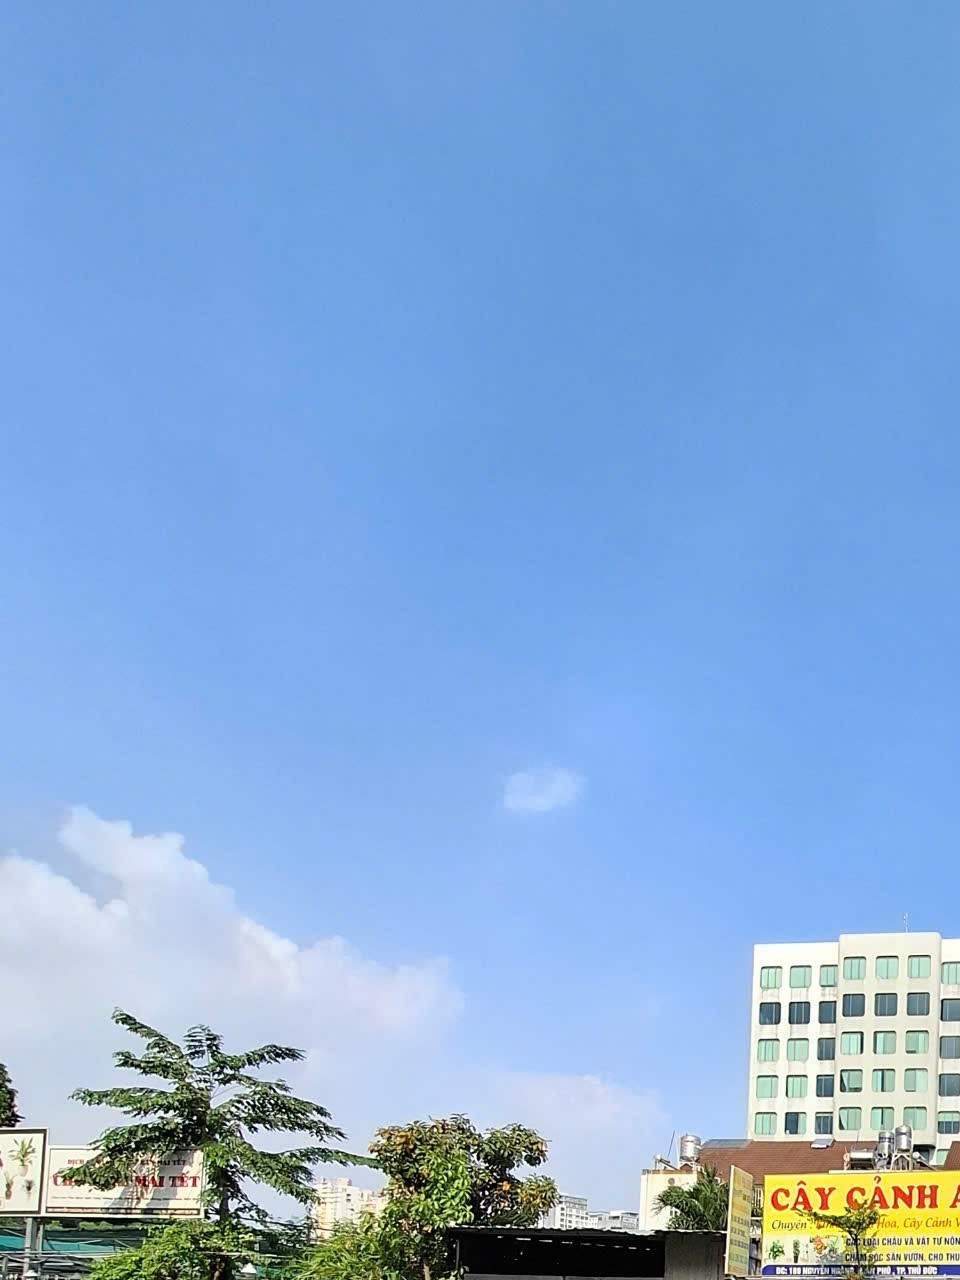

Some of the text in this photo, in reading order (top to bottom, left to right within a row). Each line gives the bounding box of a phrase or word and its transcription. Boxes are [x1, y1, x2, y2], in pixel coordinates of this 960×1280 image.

[135, 1171, 200, 1187] MAI TẾT
[770, 1180, 836, 1212] CÂY
[846, 1175, 939, 1210] CẢNH
[772, 1219, 807, 1231] Chuyên
[903, 1216, 923, 1229] Cây
[928, 1252, 944, 1262] CHO
